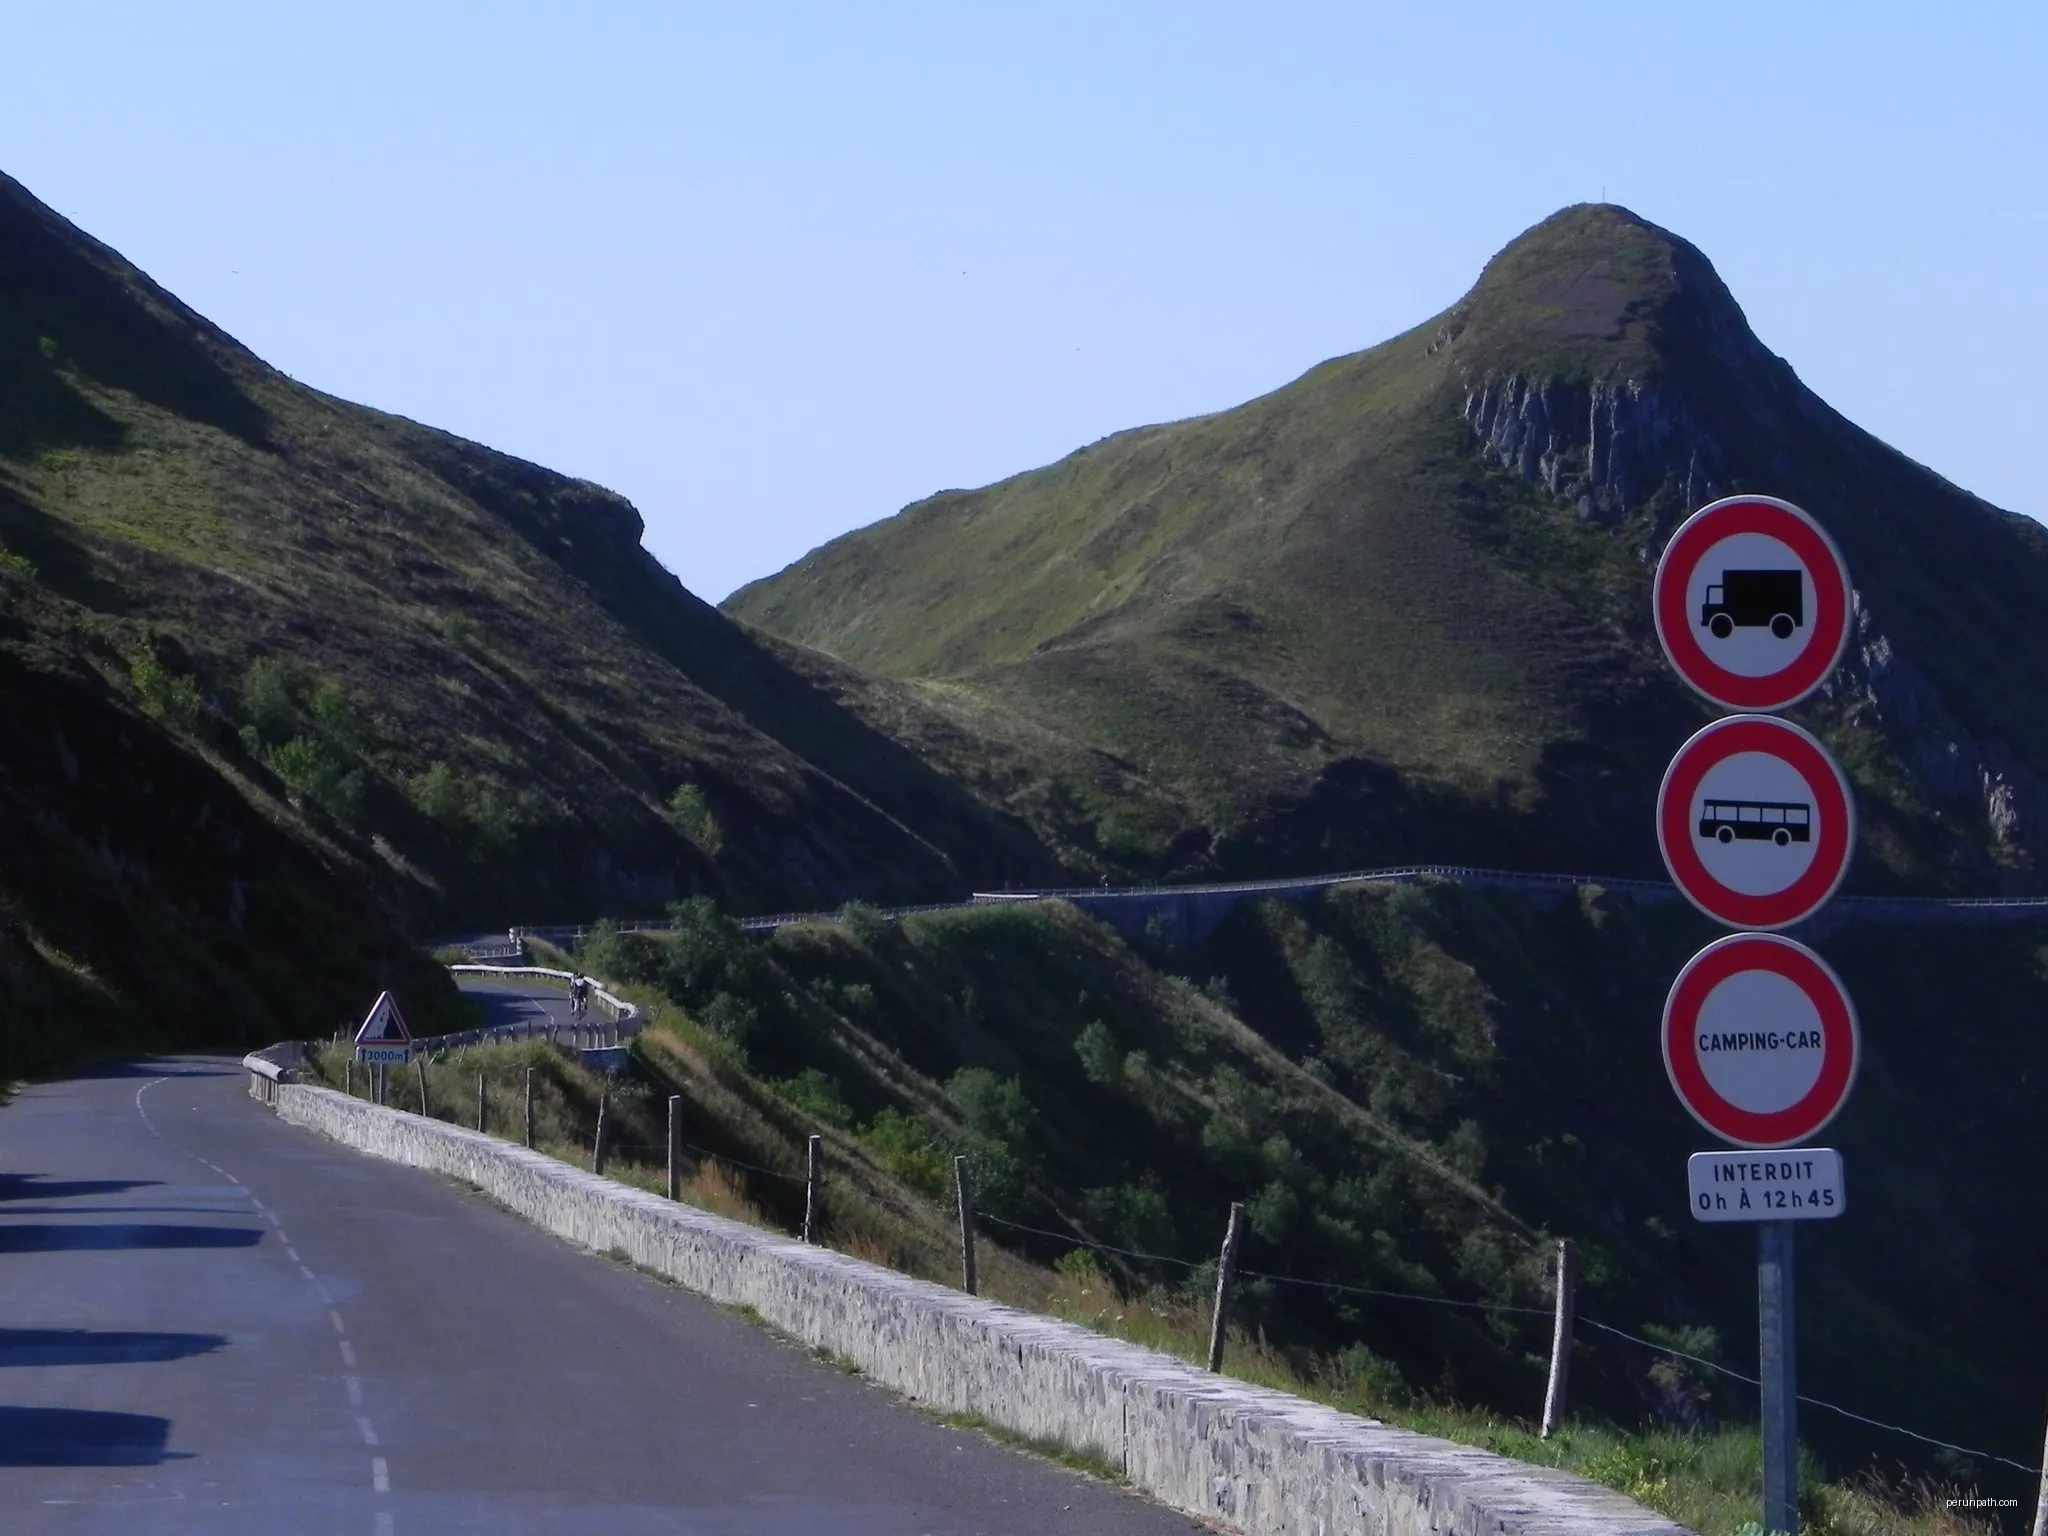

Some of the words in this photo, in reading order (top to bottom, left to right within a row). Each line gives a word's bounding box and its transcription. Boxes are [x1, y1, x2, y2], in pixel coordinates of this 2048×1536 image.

[1699, 1031, 1821, 1052] CAMPING-CAR
[1714, 1162, 1813, 1182] INTERDIT
[1739, 1188, 1751, 1209] À
[1764, 1189, 1834, 1209] 12h45
